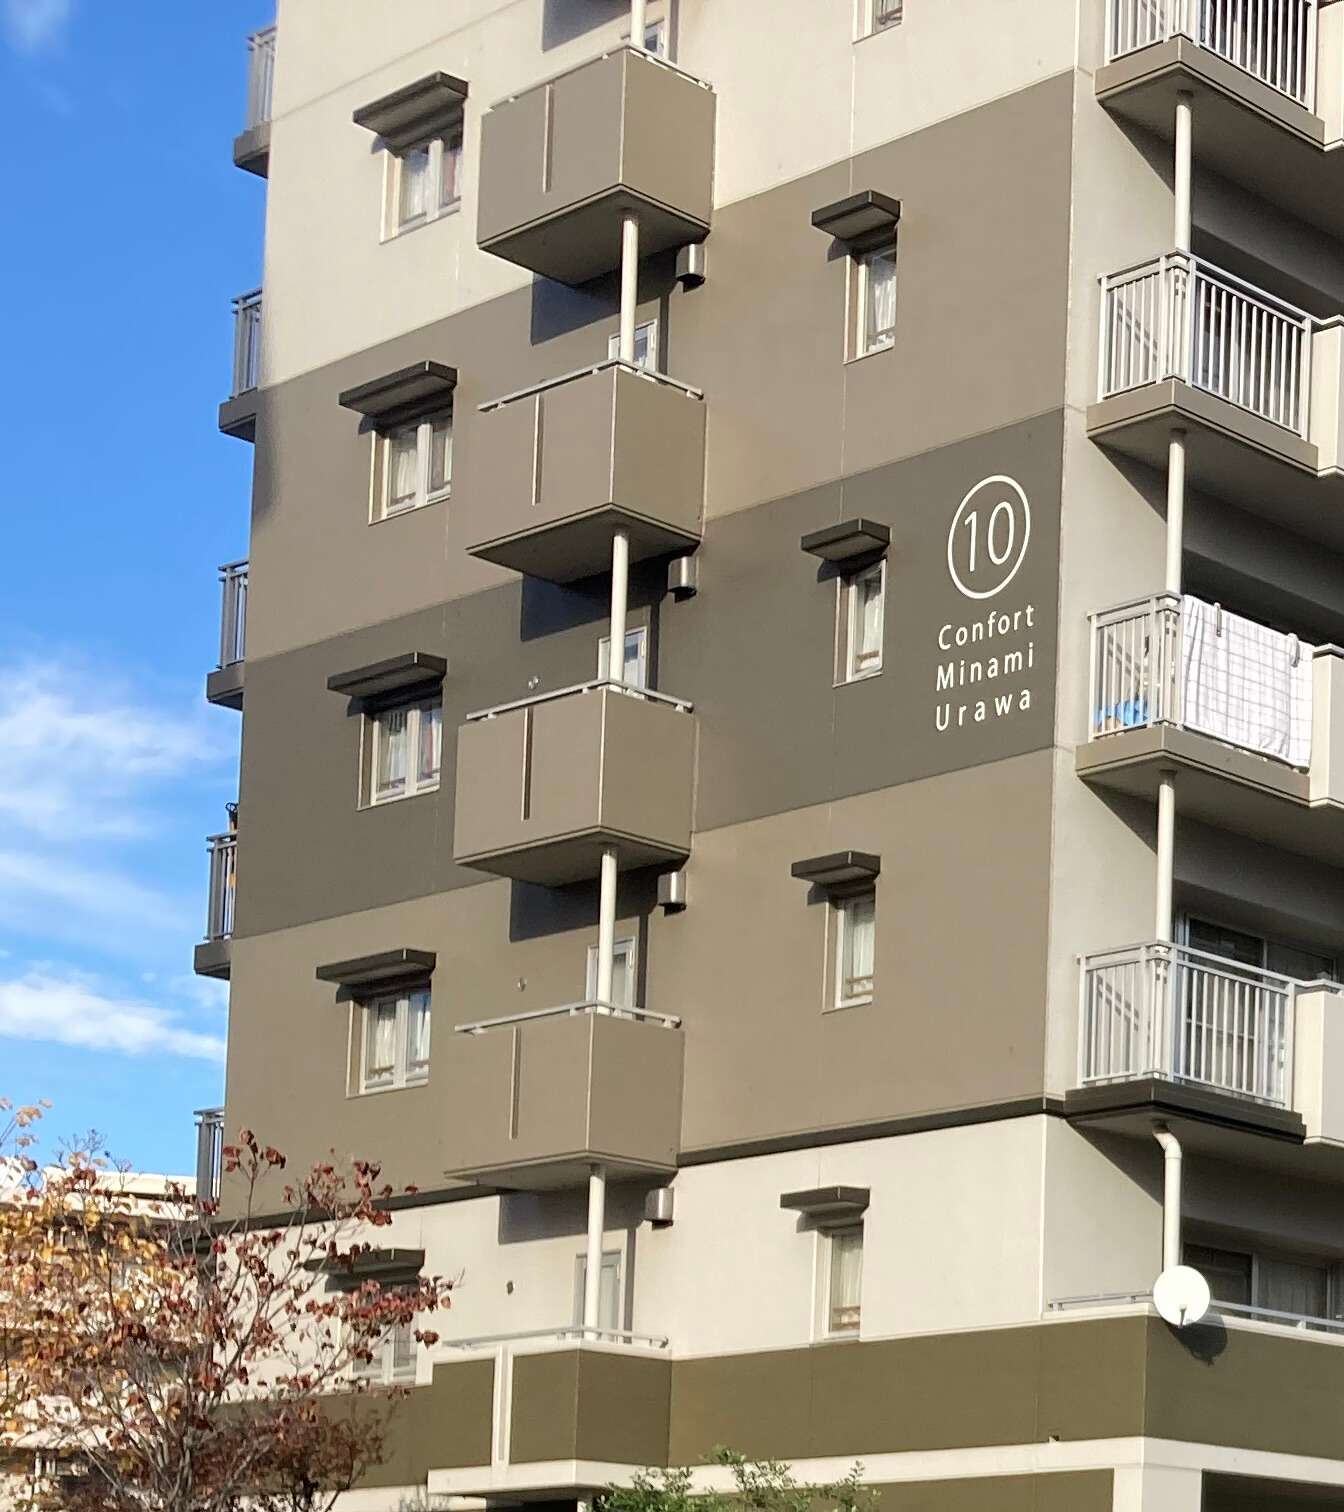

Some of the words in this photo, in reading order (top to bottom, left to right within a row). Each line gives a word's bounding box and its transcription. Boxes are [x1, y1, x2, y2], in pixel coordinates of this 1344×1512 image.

[965, 501, 1015, 572] 10
[938, 604, 1035, 650] Confort
[936, 642, 1034, 691] Minami
[935, 689, 1031, 731] Urawa
